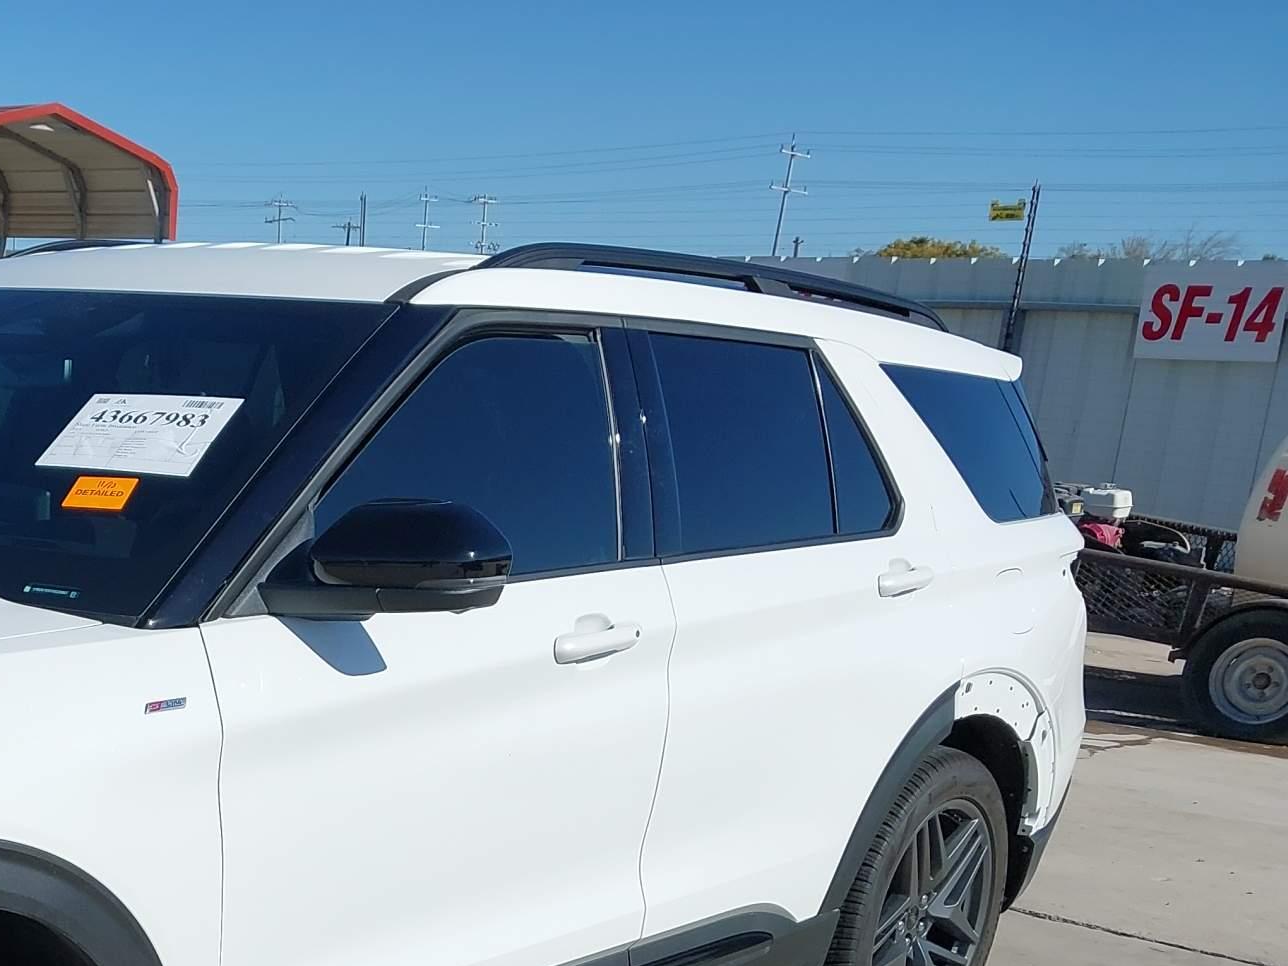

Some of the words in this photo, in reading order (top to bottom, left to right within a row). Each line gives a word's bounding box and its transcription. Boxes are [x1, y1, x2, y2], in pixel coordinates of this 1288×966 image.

[1141, 283, 1285, 343] SF-14
[90, 409, 210, 428] 43667983
[74, 488, 125, 497] DETAILED
